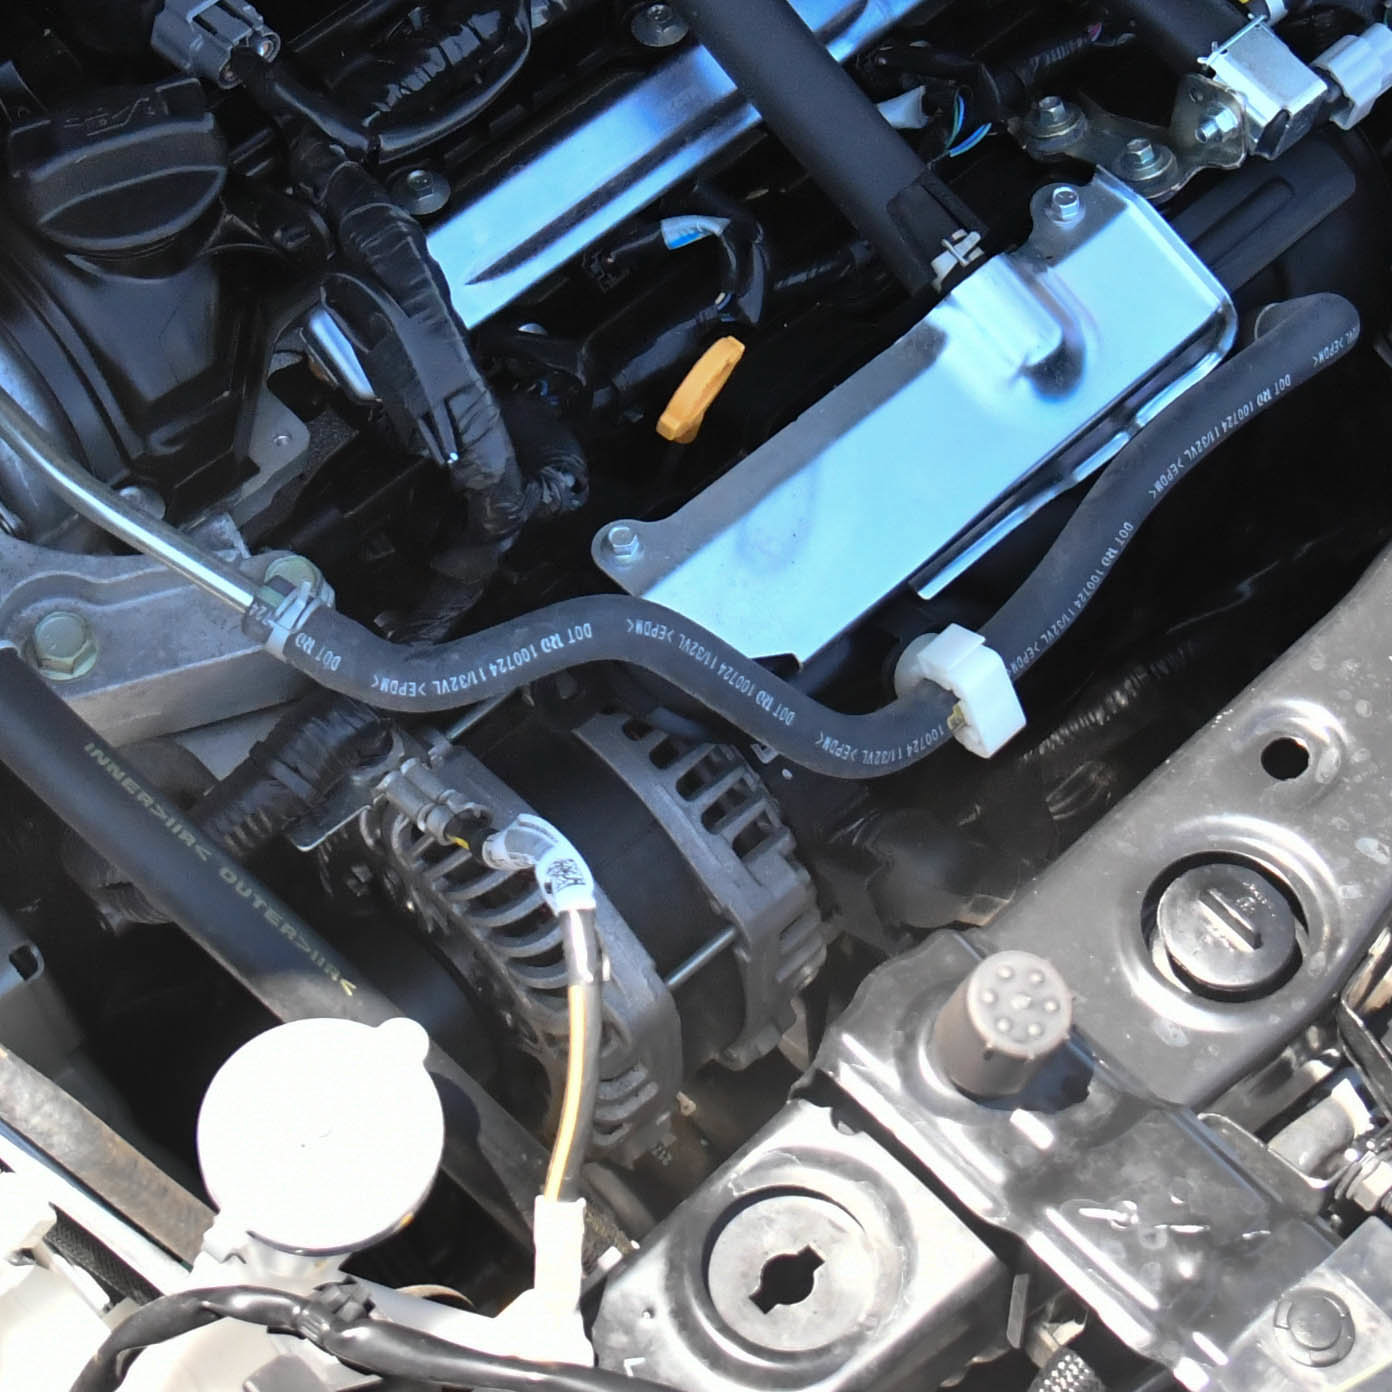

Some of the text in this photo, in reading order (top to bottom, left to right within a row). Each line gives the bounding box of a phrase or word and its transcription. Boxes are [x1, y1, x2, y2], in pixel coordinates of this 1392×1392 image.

[1220, 400, 1254, 432] 100724
[1112, 520, 1134, 545] DOT
[1072, 568, 1103, 609] 100724
[566, 622, 592, 643] DOT
[314, 646, 341, 671] DOT
[488, 643, 537, 677] 100724
[1008, 640, 1039, 673] >EPDM
[714, 660, 758, 697] 100724
[771, 702, 797, 726] DOT
